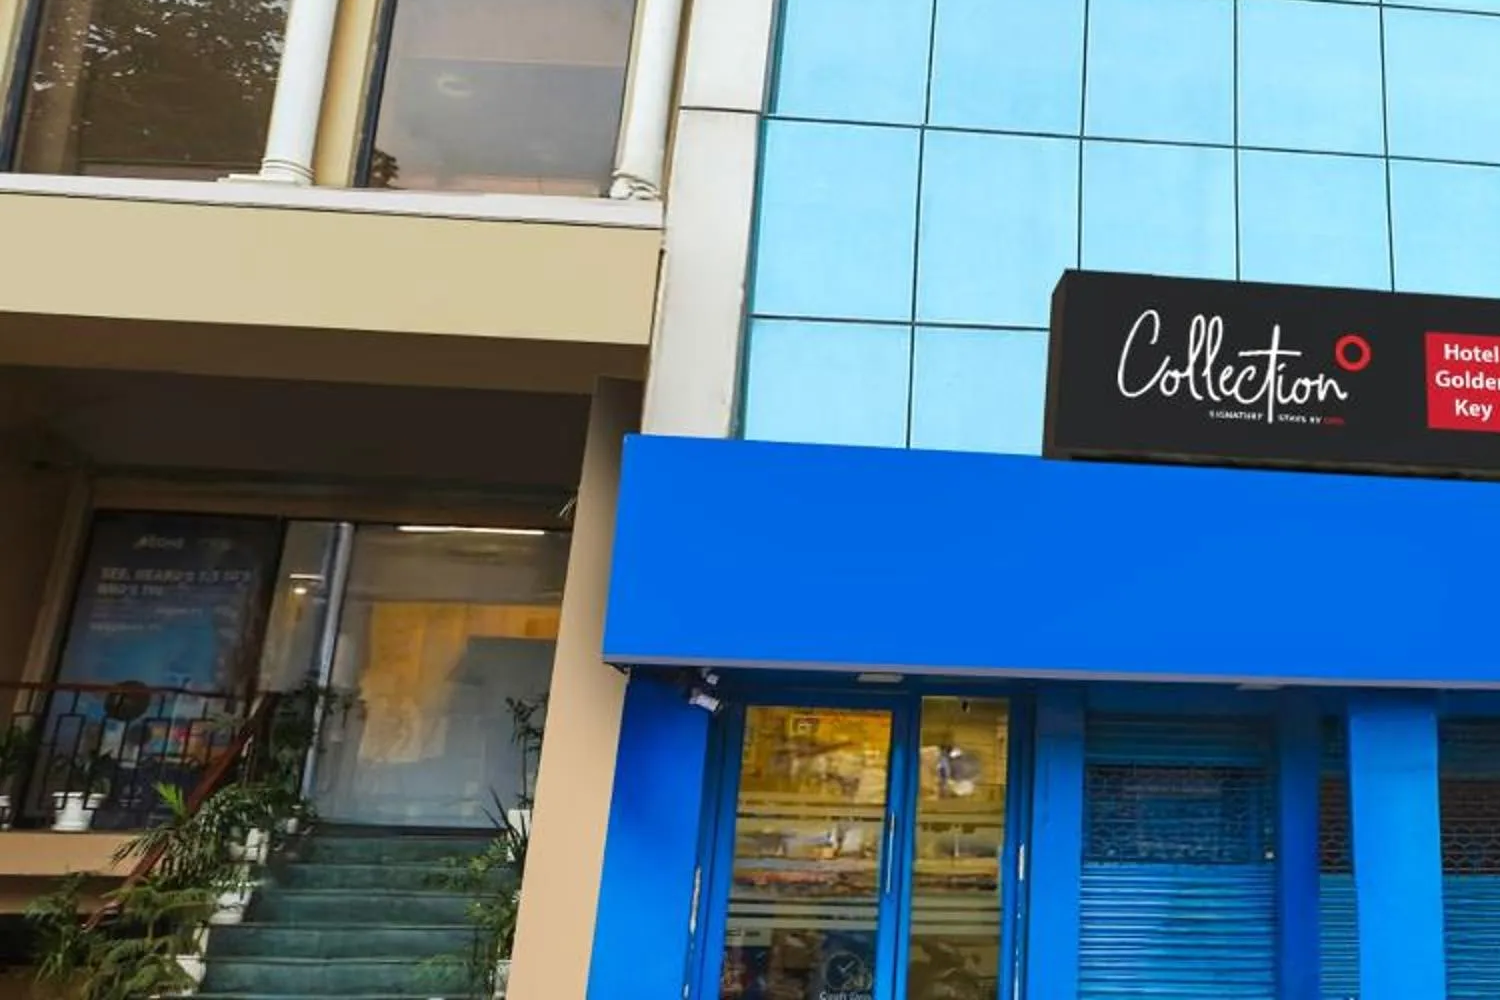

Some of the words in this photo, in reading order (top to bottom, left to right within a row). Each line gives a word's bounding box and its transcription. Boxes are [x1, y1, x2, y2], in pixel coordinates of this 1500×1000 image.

[1443, 342, 1500, 364] Hotel
[1116, 308, 1349, 424] Collection
[1454, 397, 1494, 421] Key
